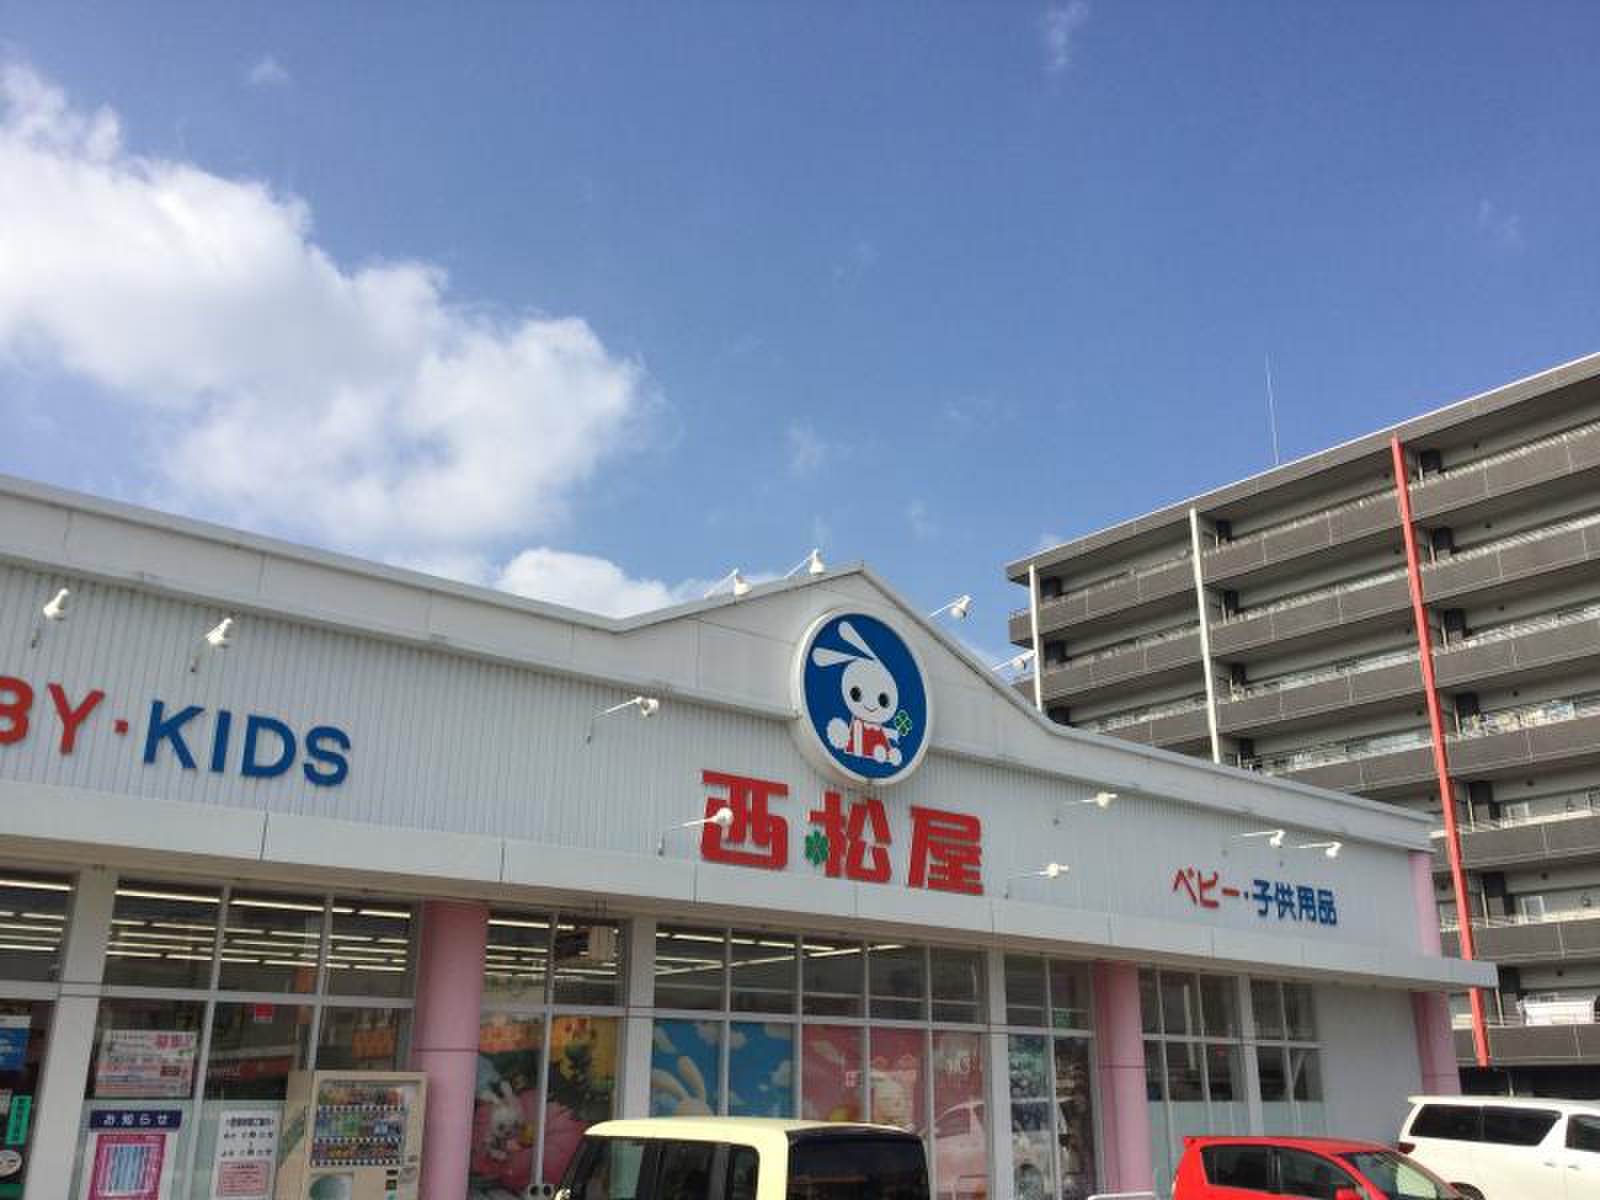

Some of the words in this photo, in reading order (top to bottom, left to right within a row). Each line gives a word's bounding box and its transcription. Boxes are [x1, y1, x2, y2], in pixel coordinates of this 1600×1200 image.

[702, 769, 984, 896] 西松屋
[103, 1113, 168, 1125] お知らせ
